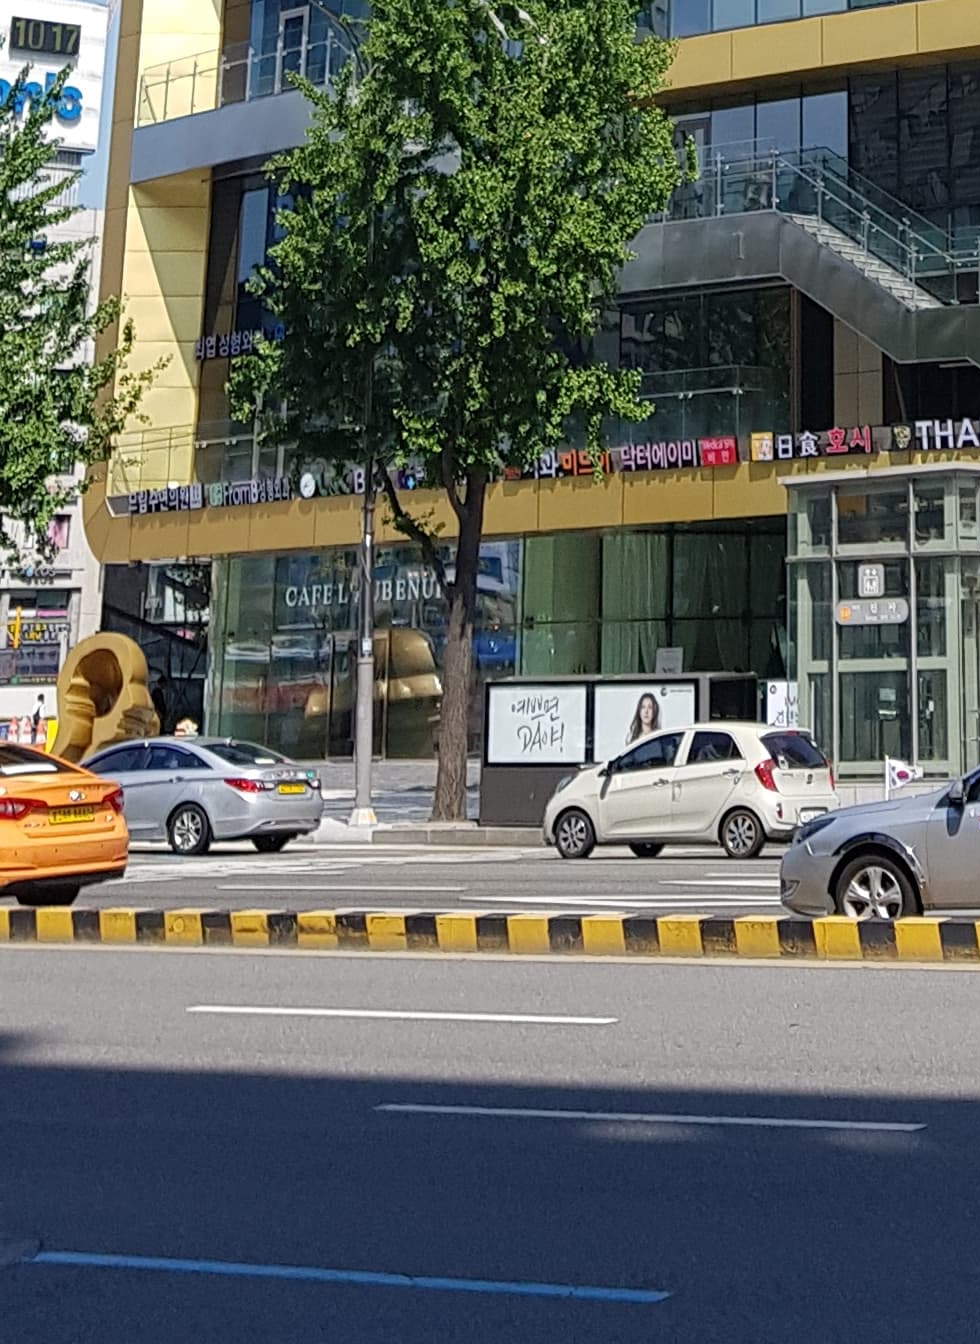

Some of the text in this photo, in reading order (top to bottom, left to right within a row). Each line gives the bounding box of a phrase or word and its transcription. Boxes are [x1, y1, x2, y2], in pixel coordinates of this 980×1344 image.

[218, 328, 265, 357] 성형외
[826, 425, 872, 454] 호시
[285, 584, 333, 607] CAFE
